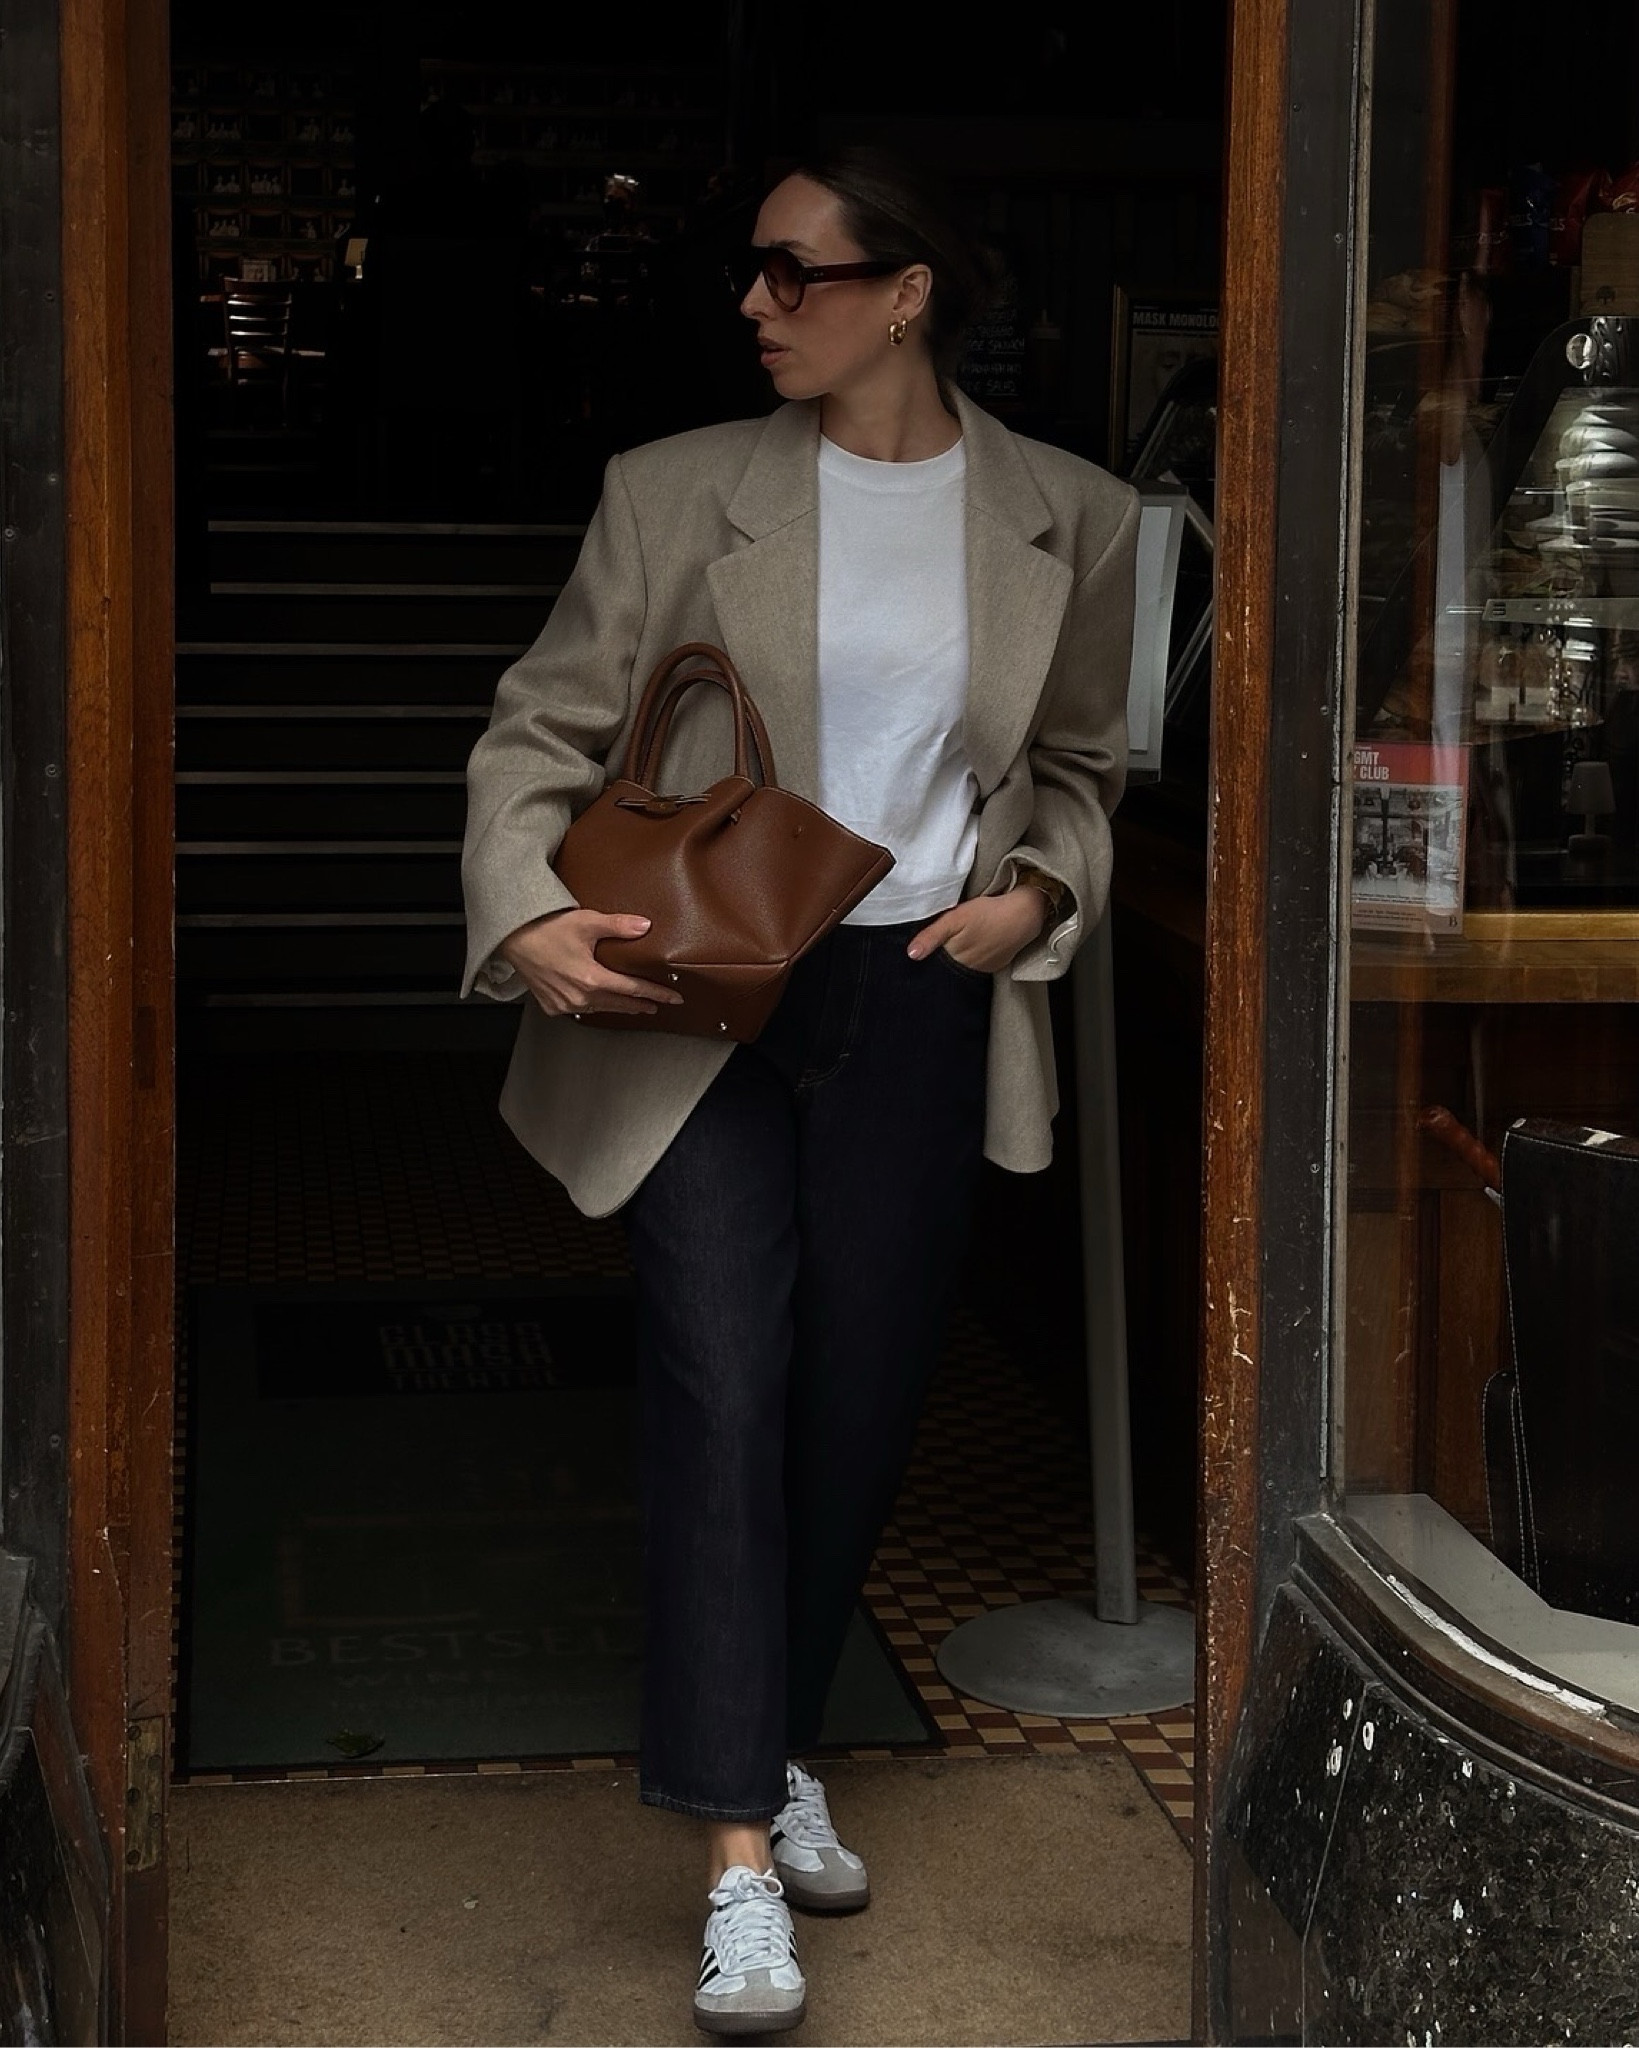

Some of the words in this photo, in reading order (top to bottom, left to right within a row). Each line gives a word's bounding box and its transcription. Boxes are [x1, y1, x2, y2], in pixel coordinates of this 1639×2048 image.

[1133, 311, 1166, 325] MASK
[1169, 313, 1218, 327] MONOLO
[1360, 766, 1390, 780] CLUB
[270, 1627, 638, 1666] BESTSEL
